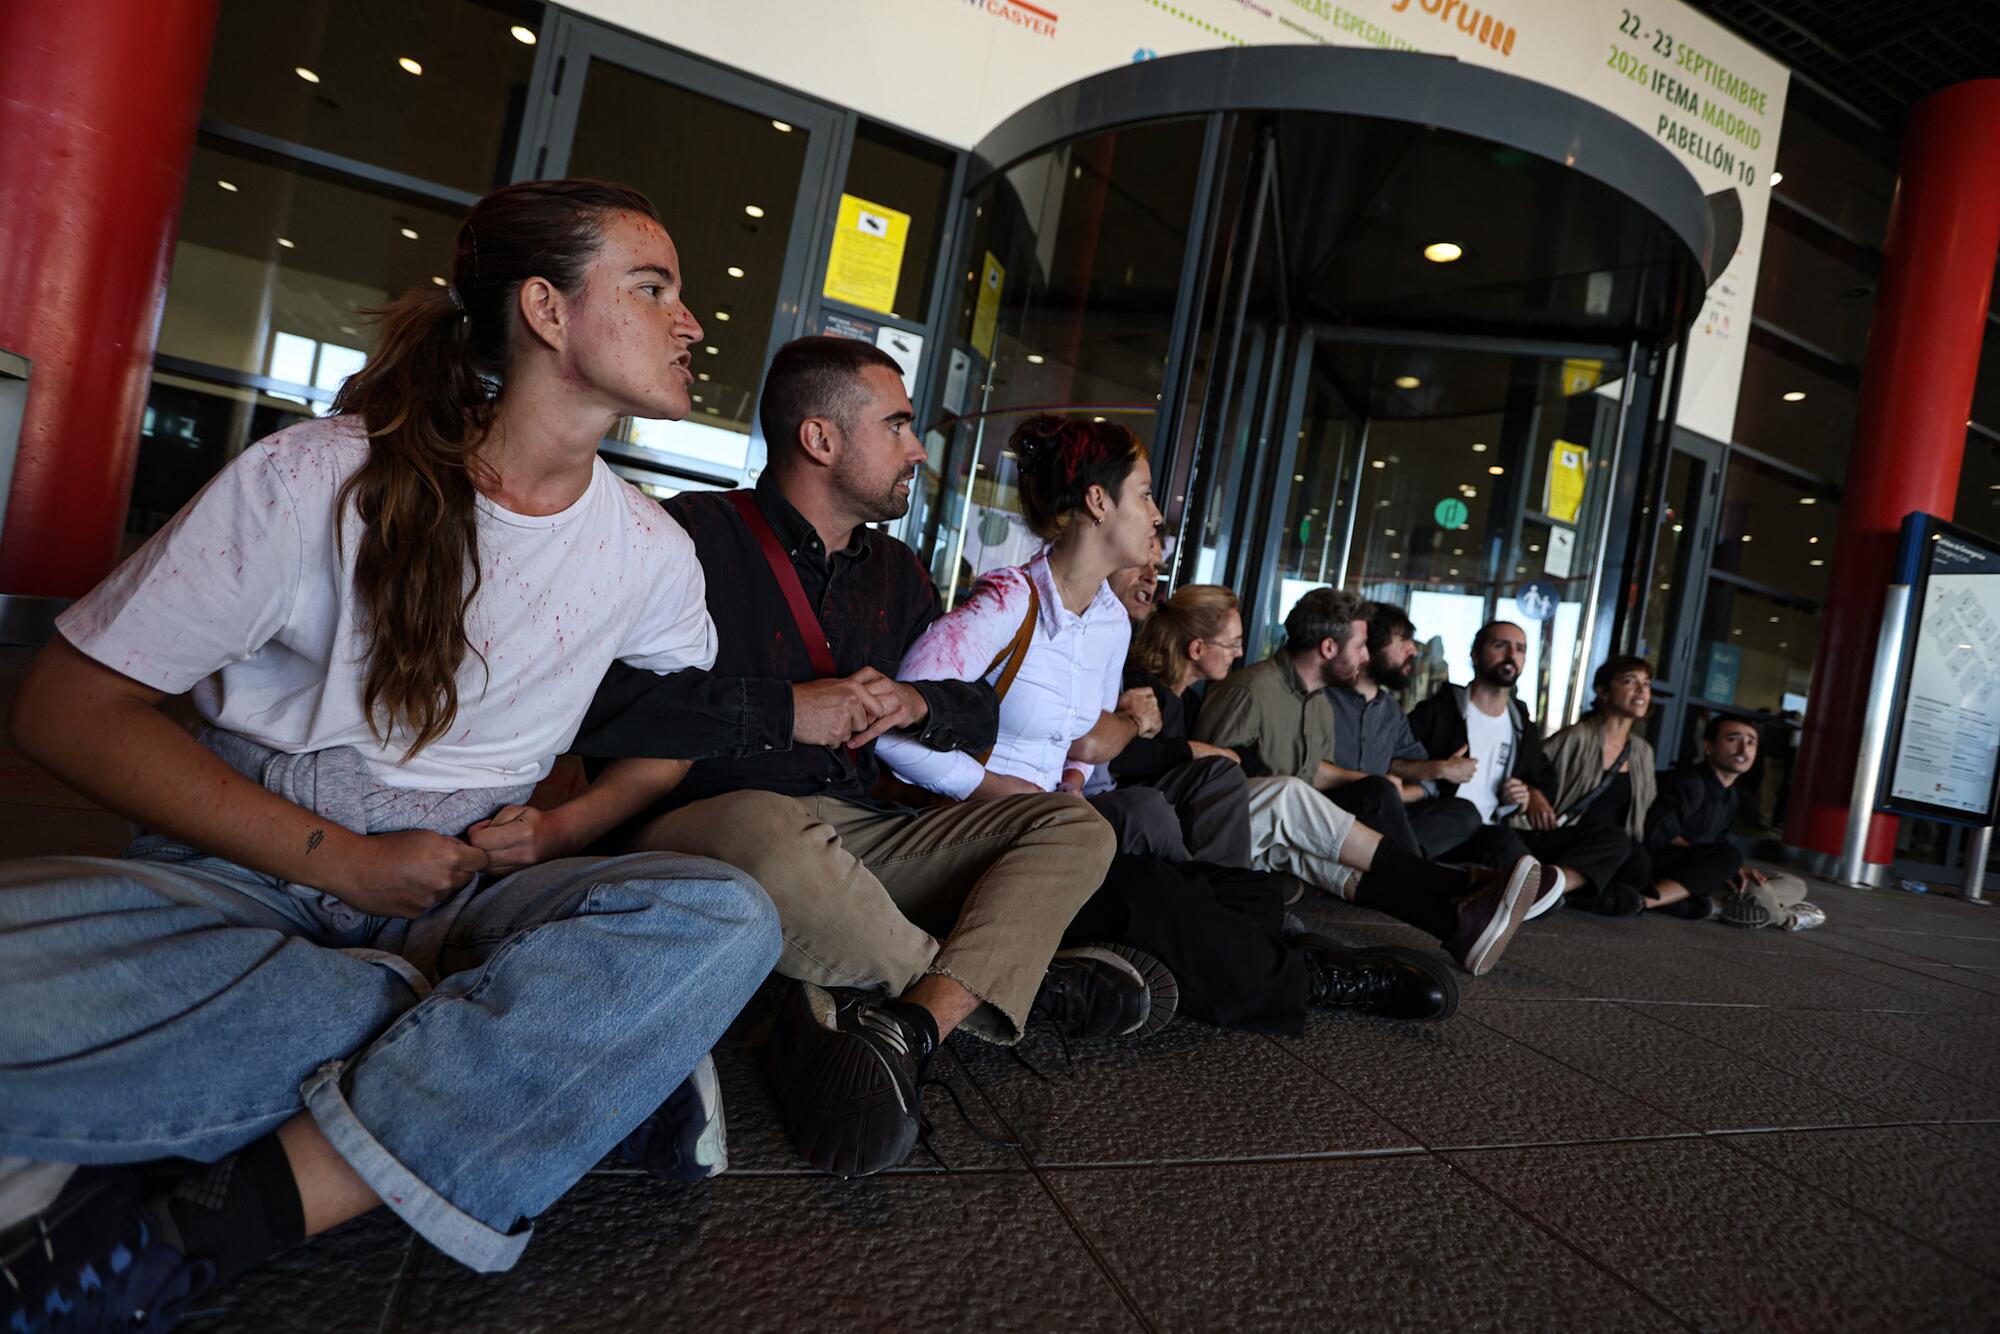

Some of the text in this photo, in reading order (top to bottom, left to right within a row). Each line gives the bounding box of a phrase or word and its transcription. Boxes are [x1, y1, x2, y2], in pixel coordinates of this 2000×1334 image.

[1607, 44, 1761, 150] 2026 IFEMA MADRID
[1619, 9, 1641, 39] 22
[1652, 29, 1673, 58] 23
[1676, 42, 1767, 116] SEPTIEMBRE
[1656, 113, 1755, 187] PABELLÓN 10
